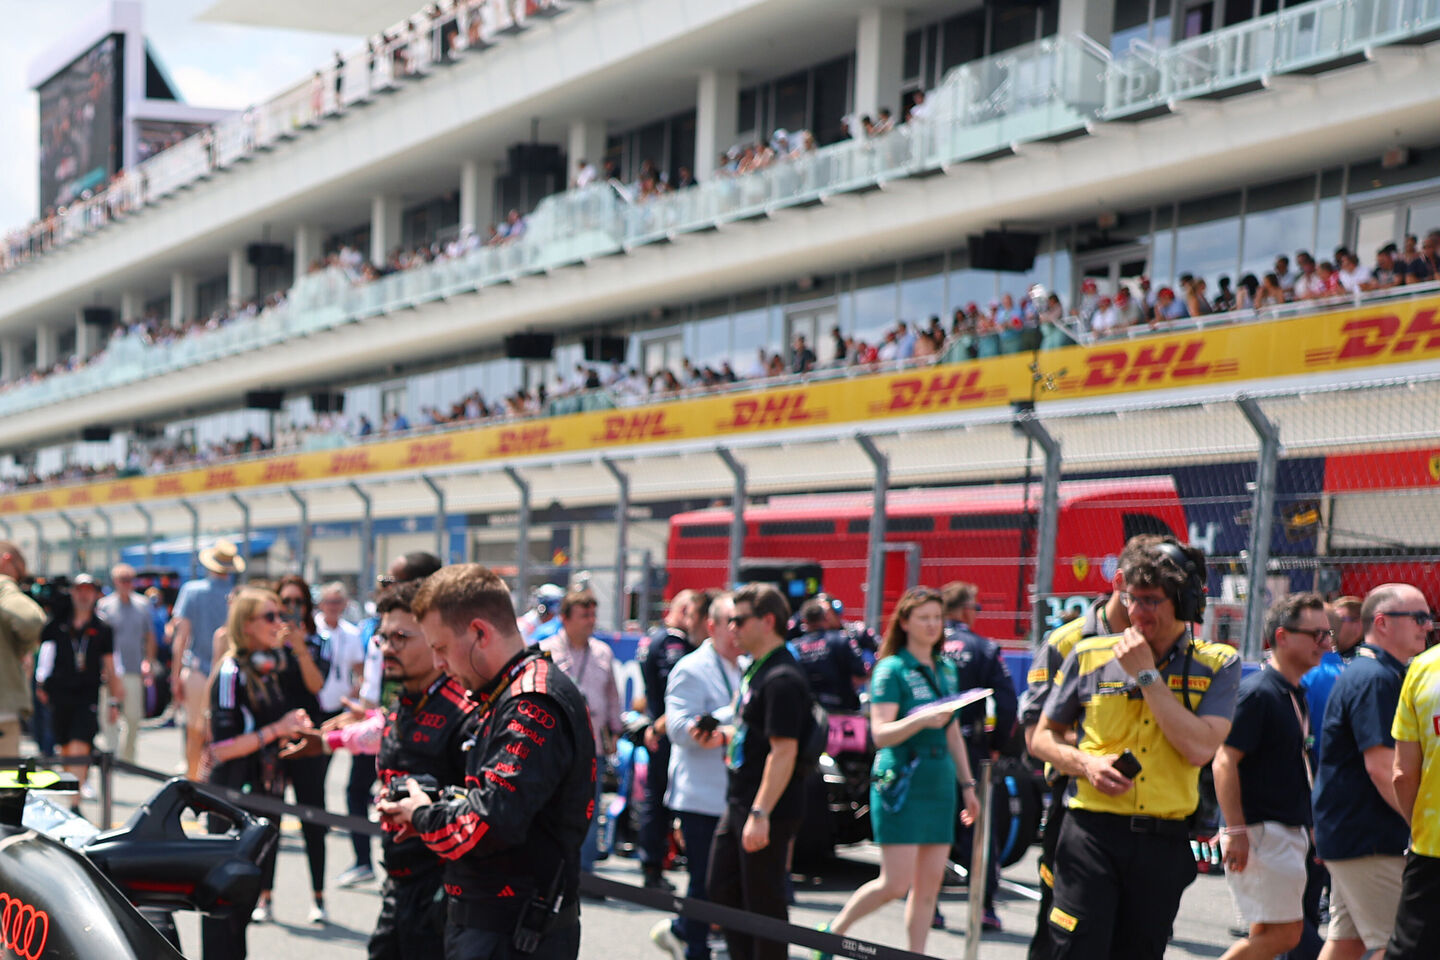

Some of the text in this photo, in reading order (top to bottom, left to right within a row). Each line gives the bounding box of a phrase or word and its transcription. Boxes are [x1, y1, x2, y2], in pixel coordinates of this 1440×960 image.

[1336, 309, 1440, 363] DH
[1083, 340, 1211, 388] DHL
[889, 369, 986, 410] DHL
[605, 410, 666, 441] DHL
[732, 394, 809, 427] DHL
[507, 719, 547, 748] Revolut
